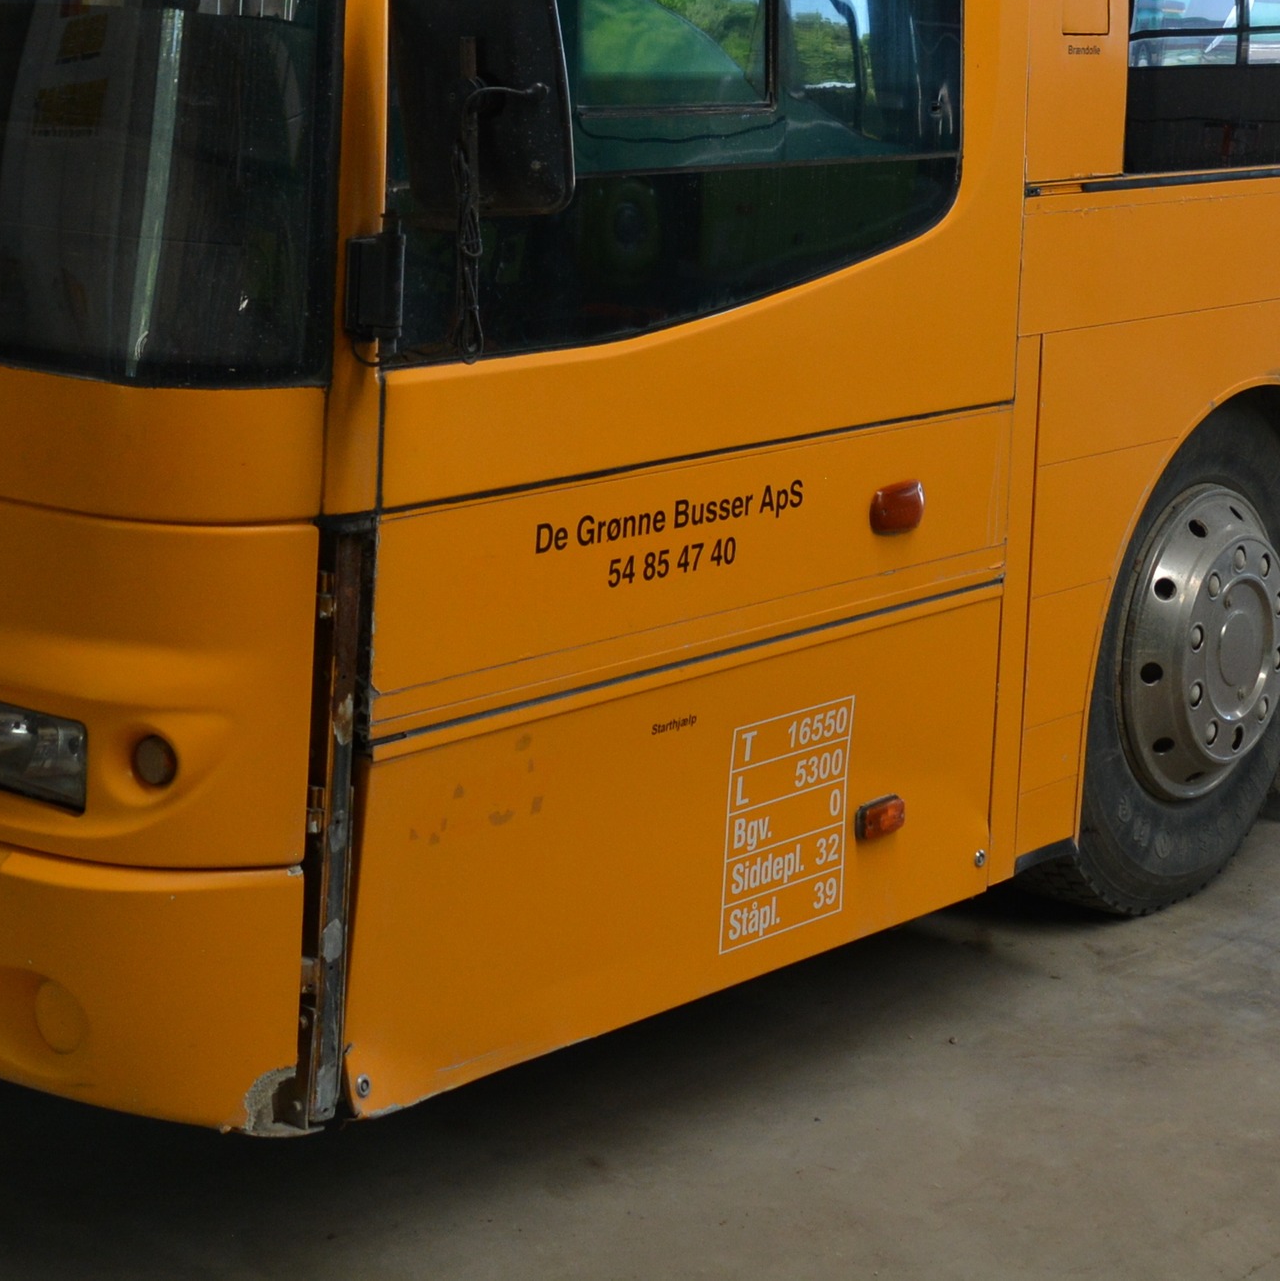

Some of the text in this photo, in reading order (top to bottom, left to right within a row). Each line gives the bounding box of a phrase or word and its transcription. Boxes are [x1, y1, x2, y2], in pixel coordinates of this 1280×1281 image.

[535, 478, 804, 554] De Grønne Busser ApS
[607, 536, 737, 588] 54 85 47 40
[651, 713, 698, 736] Starthjælp
[741, 706, 848, 762] T 16550
[735, 748, 843, 806] L 5300
[733, 788, 841, 851] Bgv. 0
[731, 833, 839, 895] Siddepl. 32
[728, 877, 837, 940] Ståpl. 39
